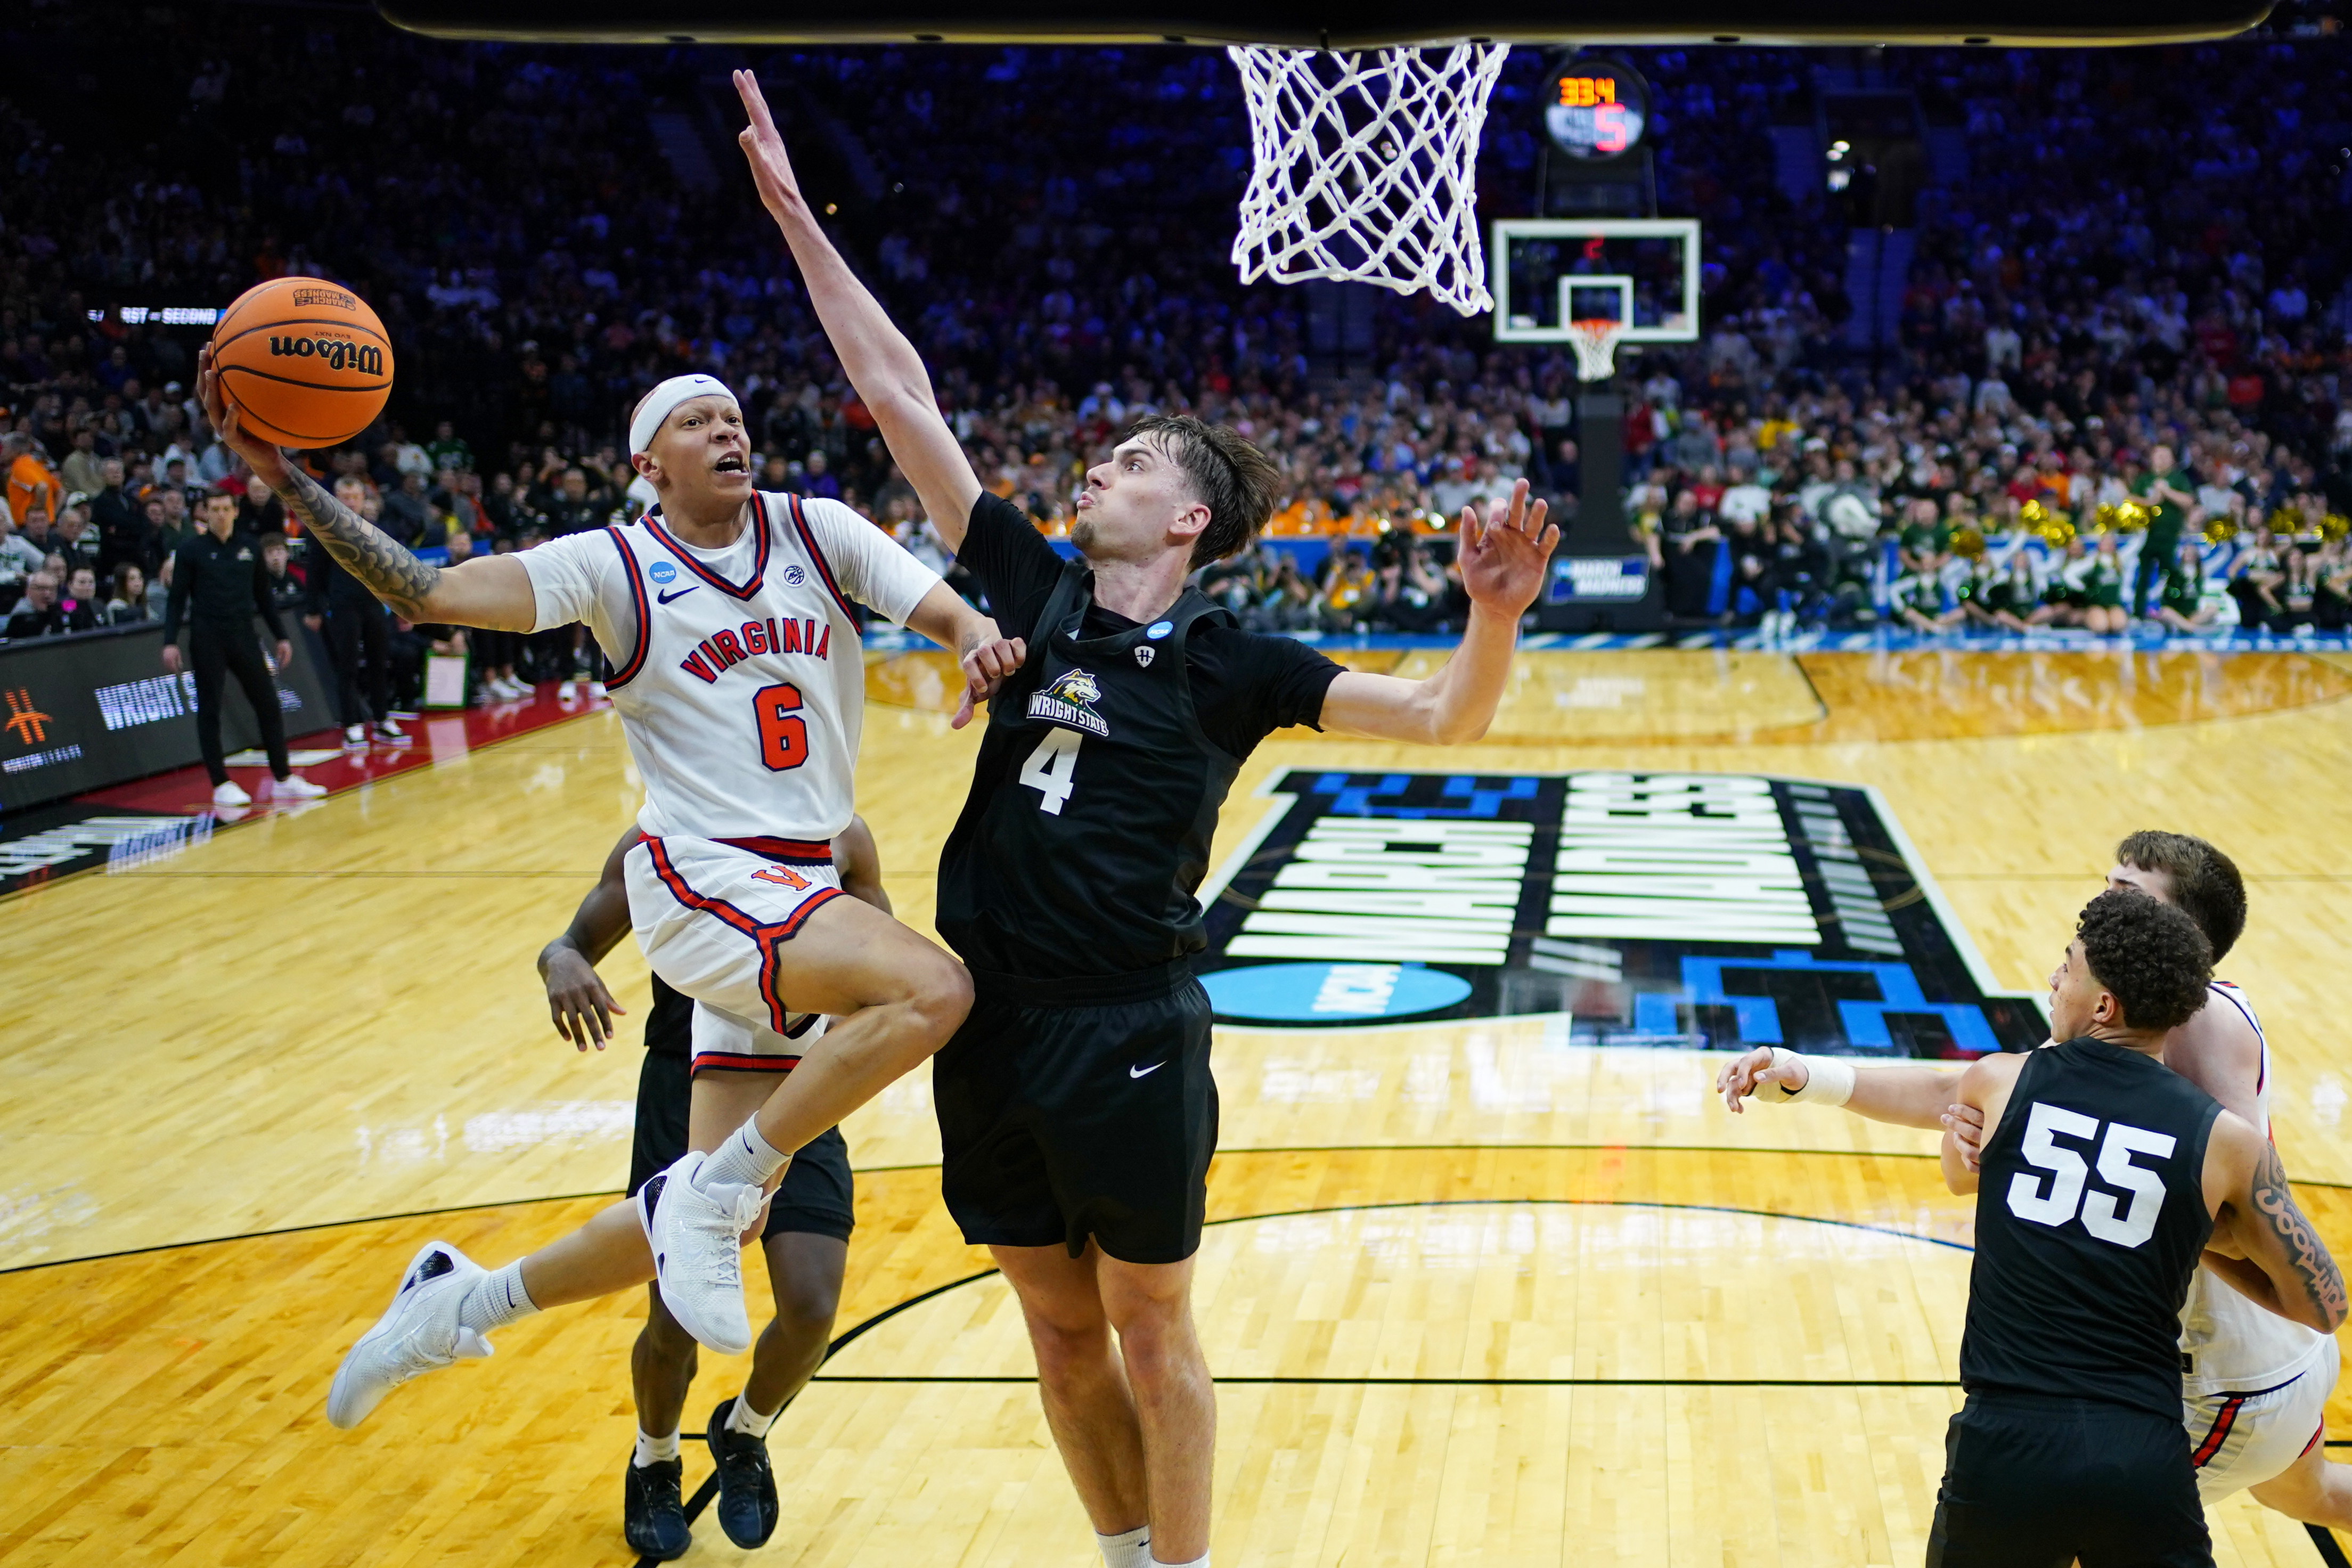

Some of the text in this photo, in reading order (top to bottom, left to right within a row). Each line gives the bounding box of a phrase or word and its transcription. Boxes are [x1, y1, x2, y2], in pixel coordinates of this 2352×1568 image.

[1595, 103, 1626, 151] 5
[293, 289, 340, 299] MADNESS
[313, 296, 346, 307] MARCH
[268, 336, 383, 377] Wilson
[654, 570, 675, 578] NCAA
[680, 617, 830, 684] VIRGINIA
[94, 673, 184, 731] WRIGHT
[1029, 694, 1107, 733] WRIGHT STATE
[752, 682, 808, 772] 6
[1019, 726, 1083, 815] 4
[2006, 1102, 2177, 1249] 55
